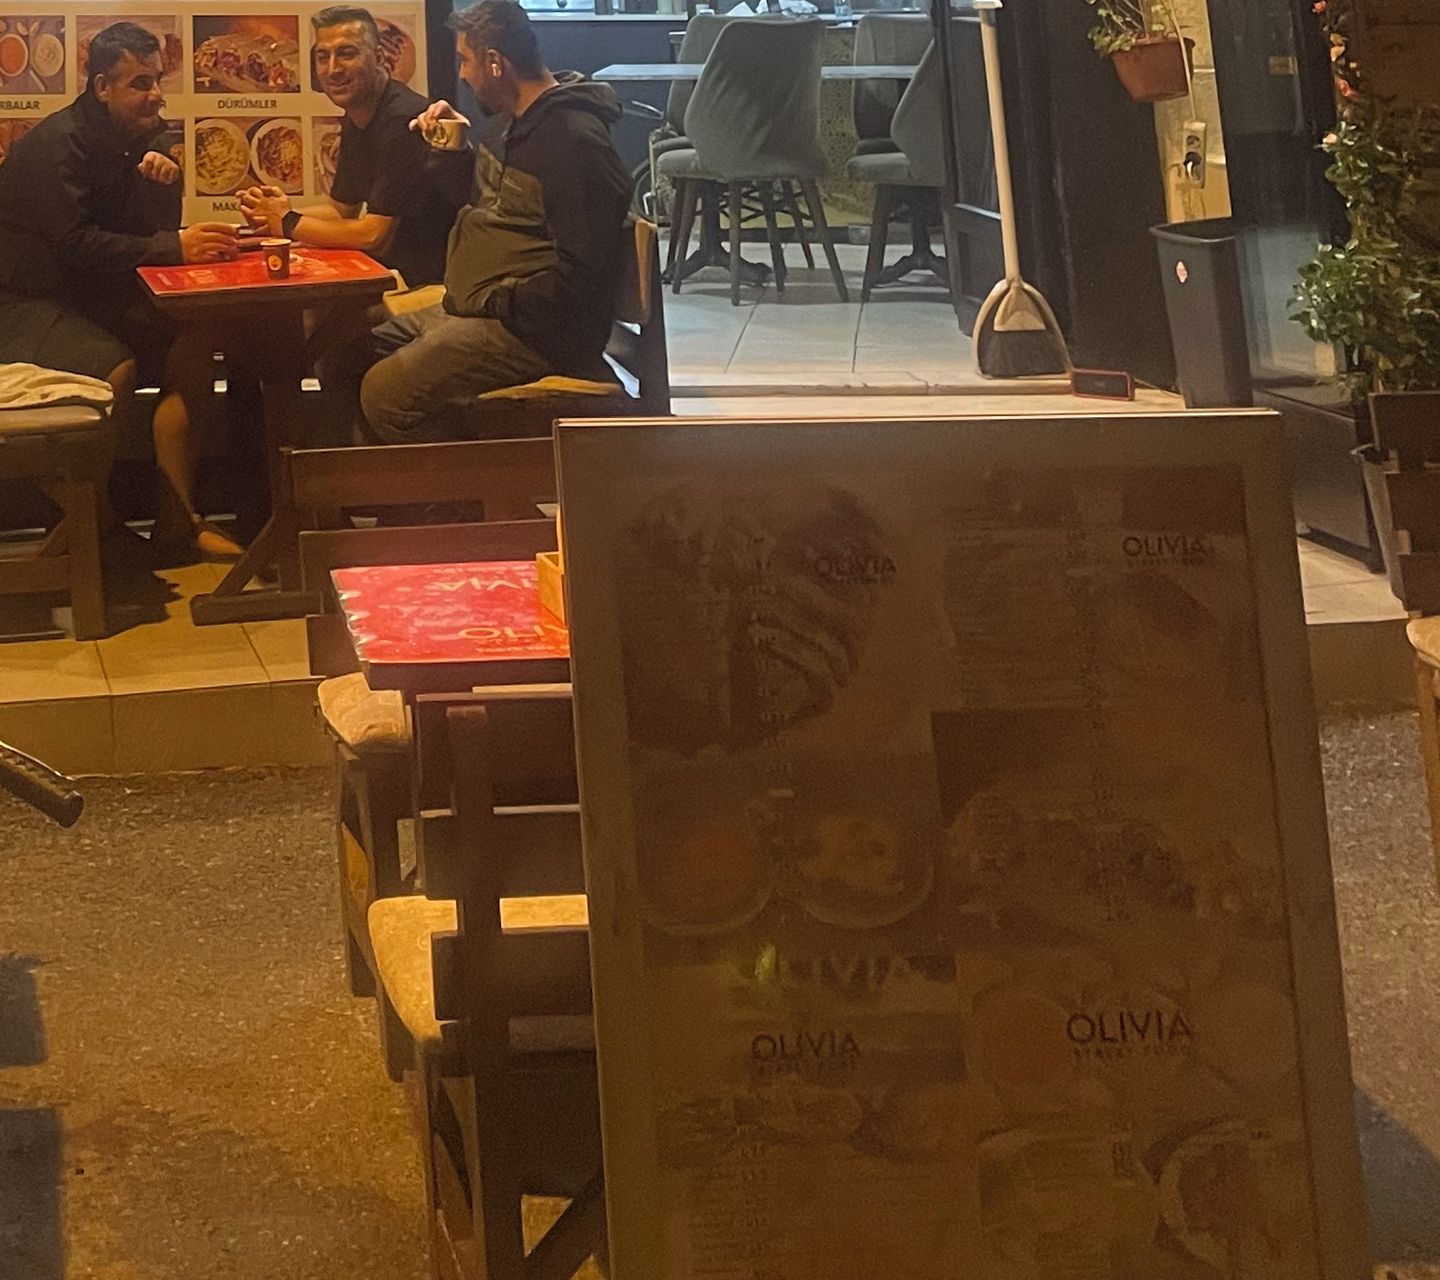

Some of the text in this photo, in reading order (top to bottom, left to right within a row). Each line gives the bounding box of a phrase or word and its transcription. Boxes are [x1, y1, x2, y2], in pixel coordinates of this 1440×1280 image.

[217, 99, 278, 110] DÜRÜMLER
[1122, 534, 1210, 558] OLIVIA
[1066, 1009, 1193, 1044] OLIVIA
[751, 1031, 862, 1061] OLIVIA
